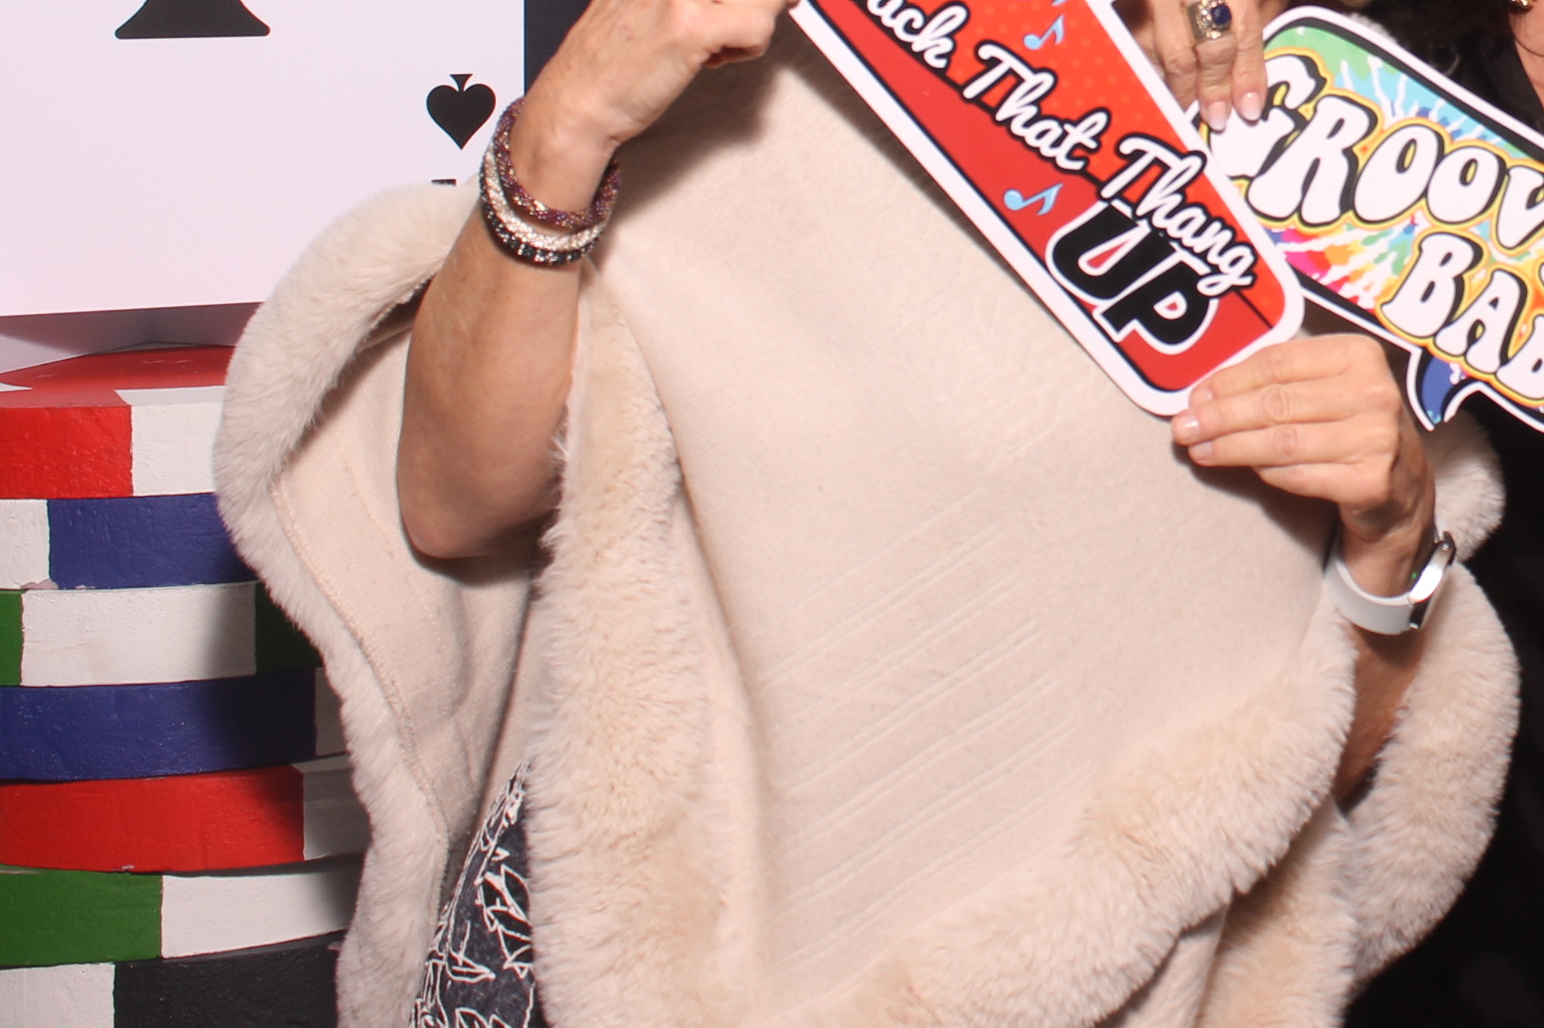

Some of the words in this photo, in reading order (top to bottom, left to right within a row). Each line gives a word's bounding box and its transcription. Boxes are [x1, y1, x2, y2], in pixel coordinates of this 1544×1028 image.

[962, 44, 1108, 171] That
[1099, 136, 1255, 297] Thang
[1046, 198, 1220, 354] UP
